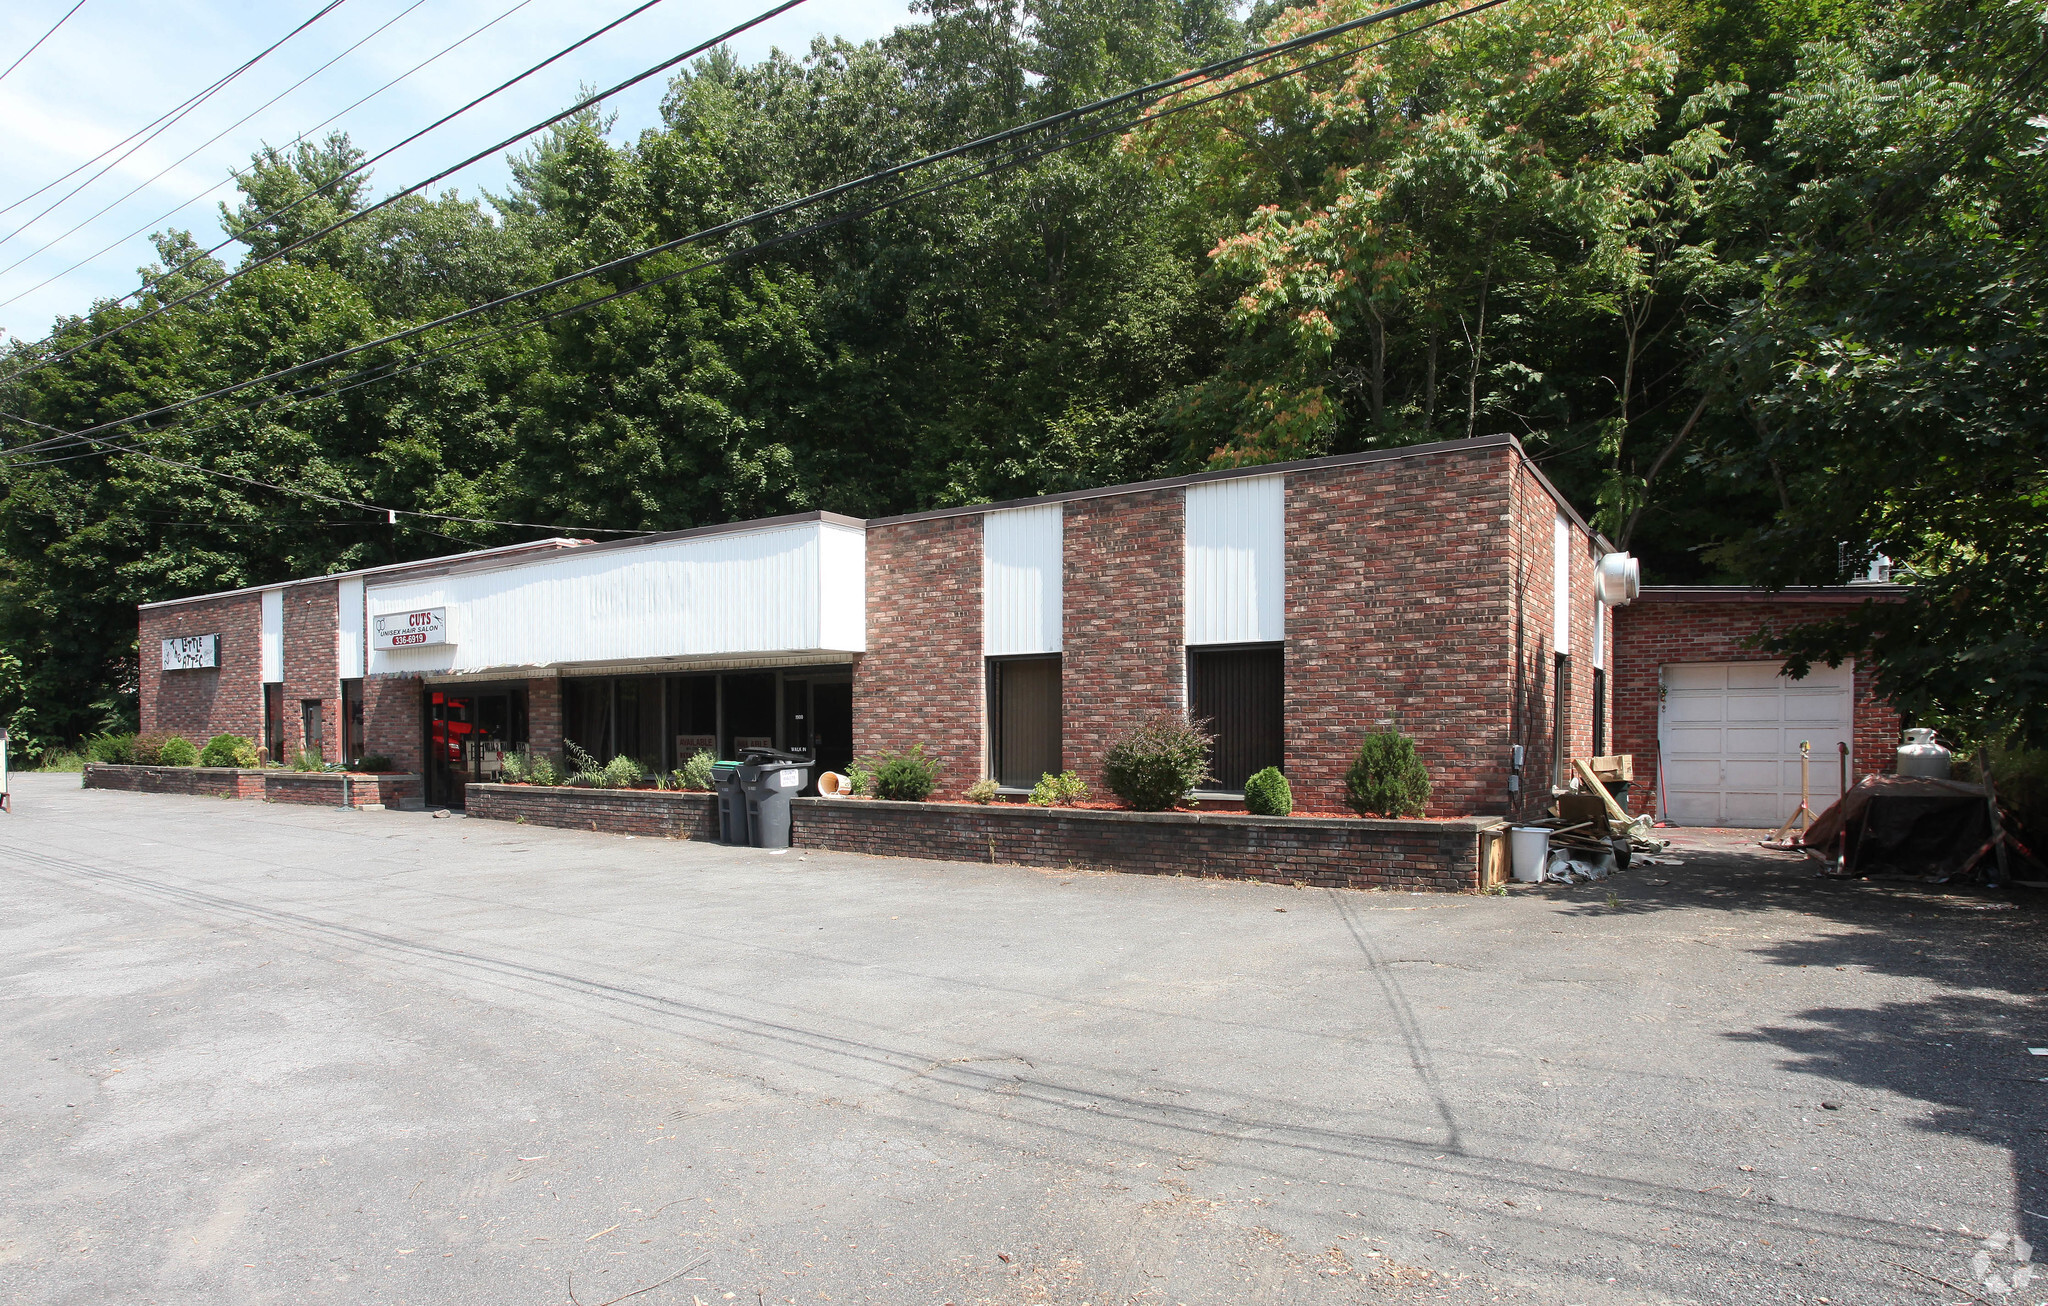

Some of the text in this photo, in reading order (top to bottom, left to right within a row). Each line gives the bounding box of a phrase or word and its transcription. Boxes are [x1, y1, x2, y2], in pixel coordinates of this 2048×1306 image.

[409, 612, 431, 626] CUTS
[380, 625, 439, 637] UNISEX HAIR SALON
[181, 637, 202, 653] LITTLE
[395, 634, 423, 645] 336-6919
[182, 653, 203, 668] ATTIC
[679, 738, 712, 747] AVAILABLE
